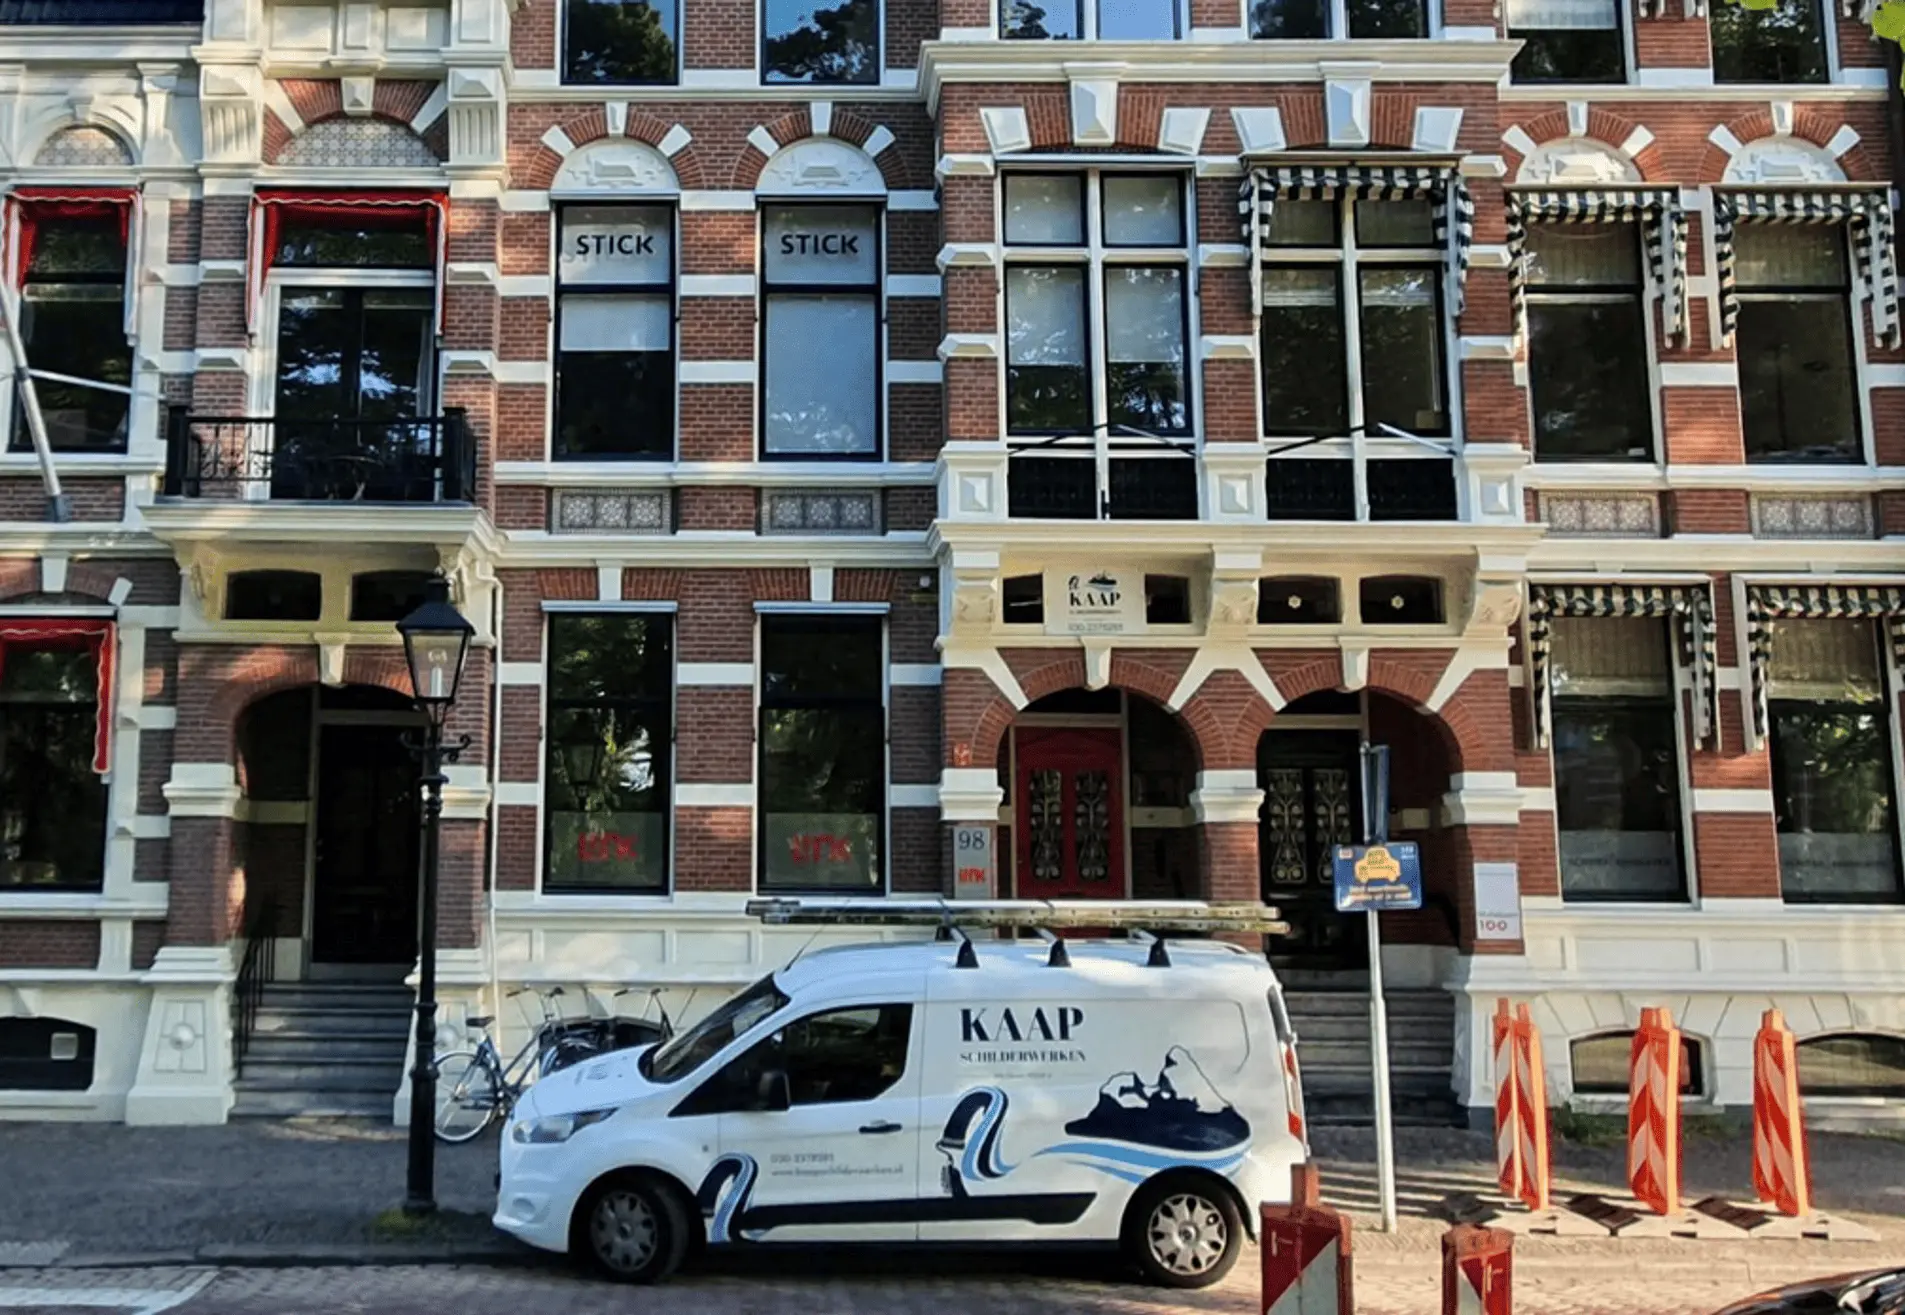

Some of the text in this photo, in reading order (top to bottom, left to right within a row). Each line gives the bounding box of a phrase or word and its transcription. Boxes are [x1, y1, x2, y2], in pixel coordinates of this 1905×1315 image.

[576, 234, 653, 254] STICK
[781, 234, 858, 254] STICK
[1069, 592, 1121, 606] KAAP
[958, 831, 985, 850] 98
[1480, 920, 1507, 931] 100
[960, 1006, 1085, 1042] KAAP
[960, 1050, 1087, 1064] SCHILDERWERKEN
